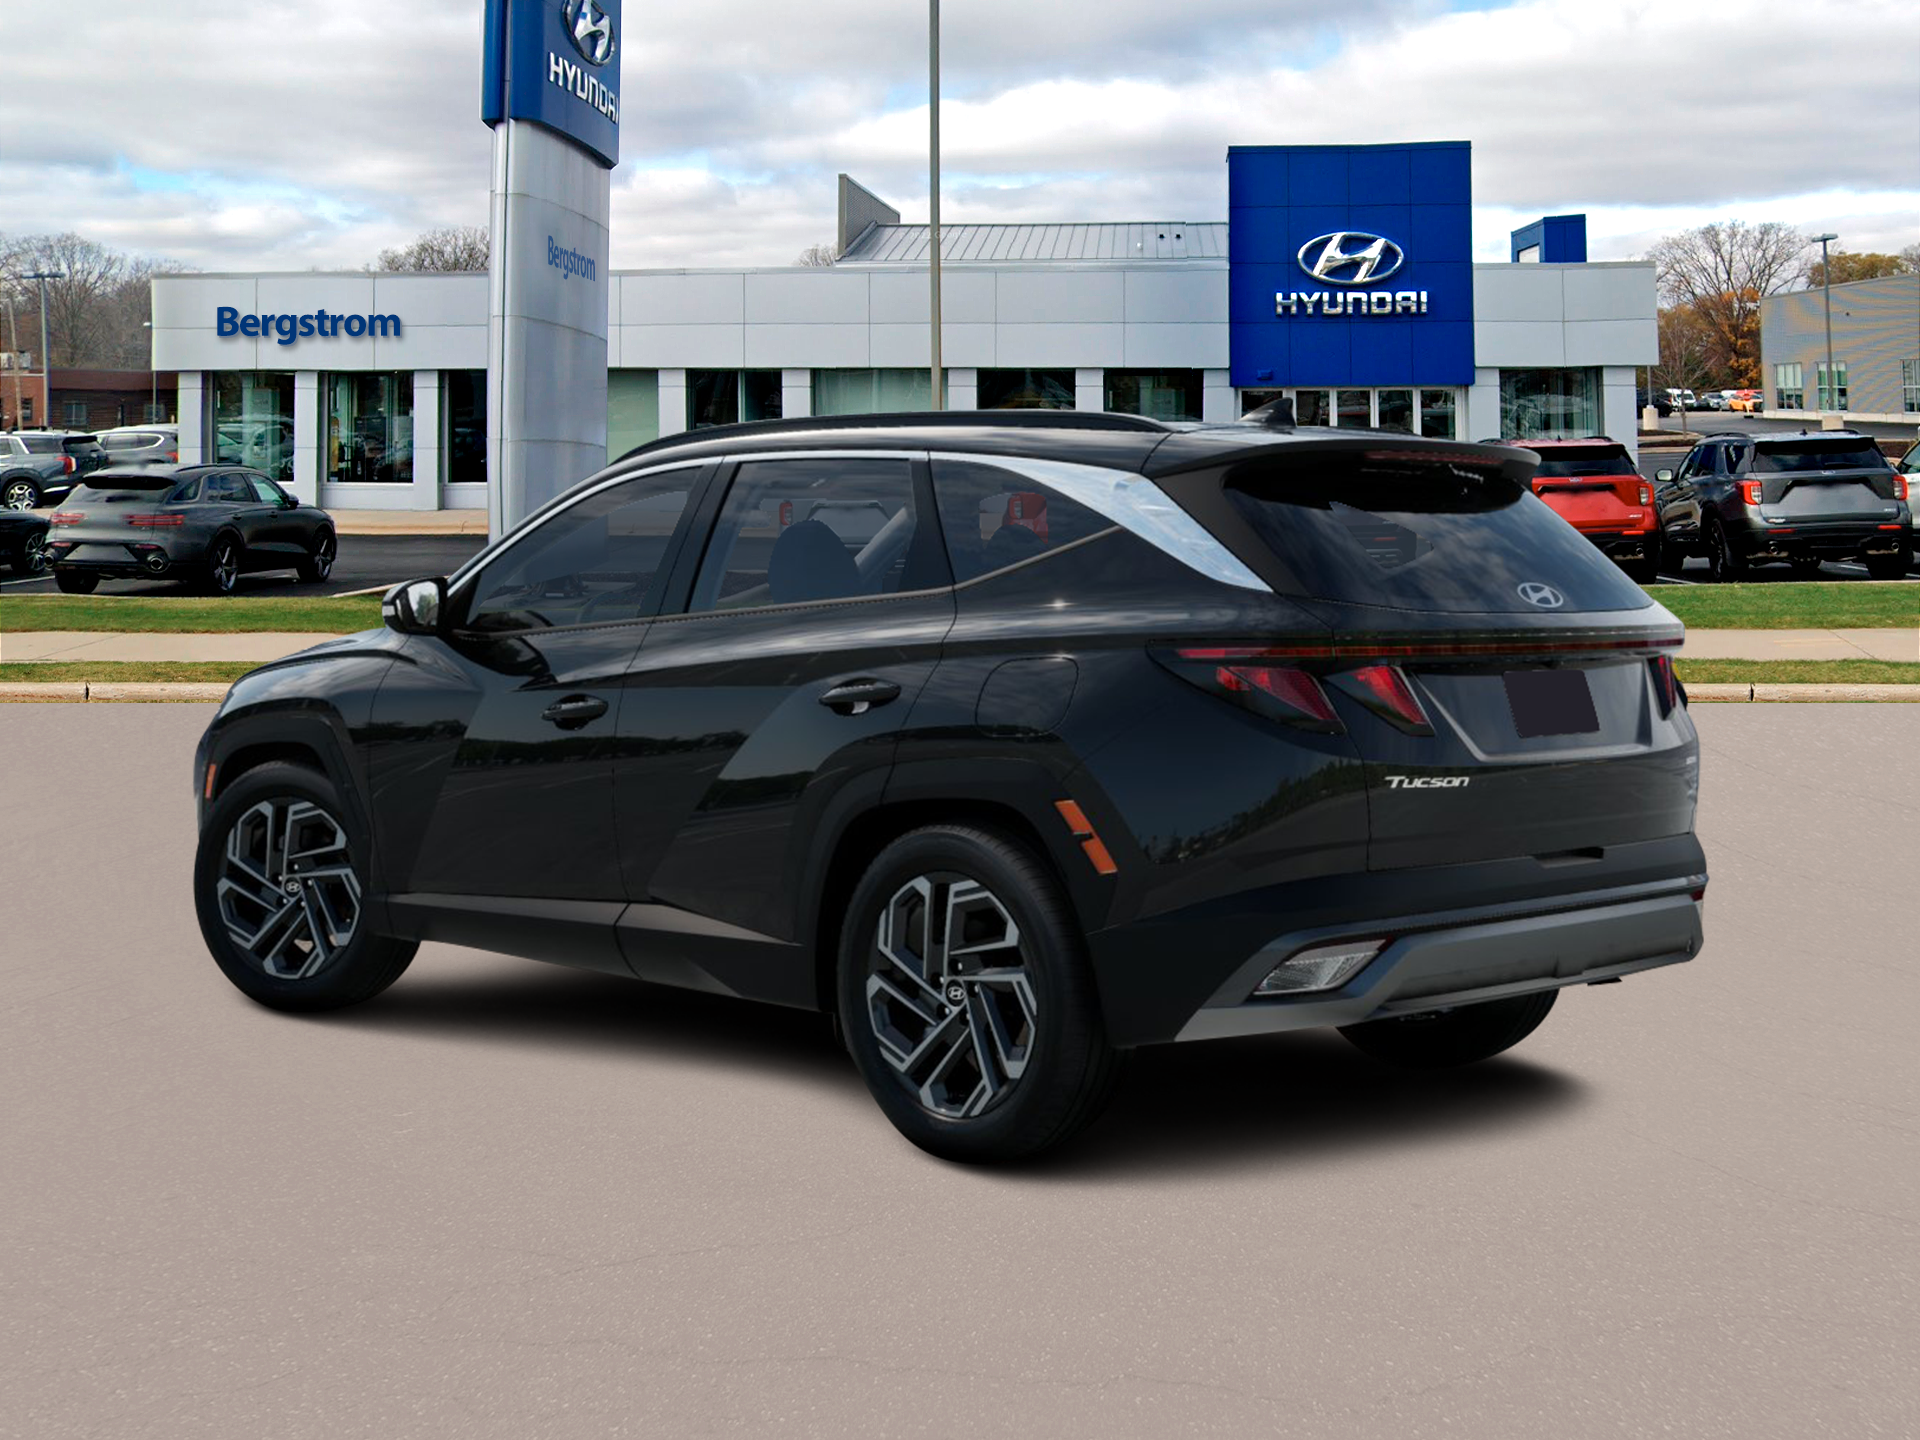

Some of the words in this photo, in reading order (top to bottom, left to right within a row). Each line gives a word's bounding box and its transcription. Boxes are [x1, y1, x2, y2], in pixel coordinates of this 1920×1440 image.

[549, 51, 619, 124] HYUNDAI
[547, 235, 596, 282] Bergstrom
[1275, 291, 1428, 315] HYUNDAI
[216, 306, 401, 345] Bergstrom
